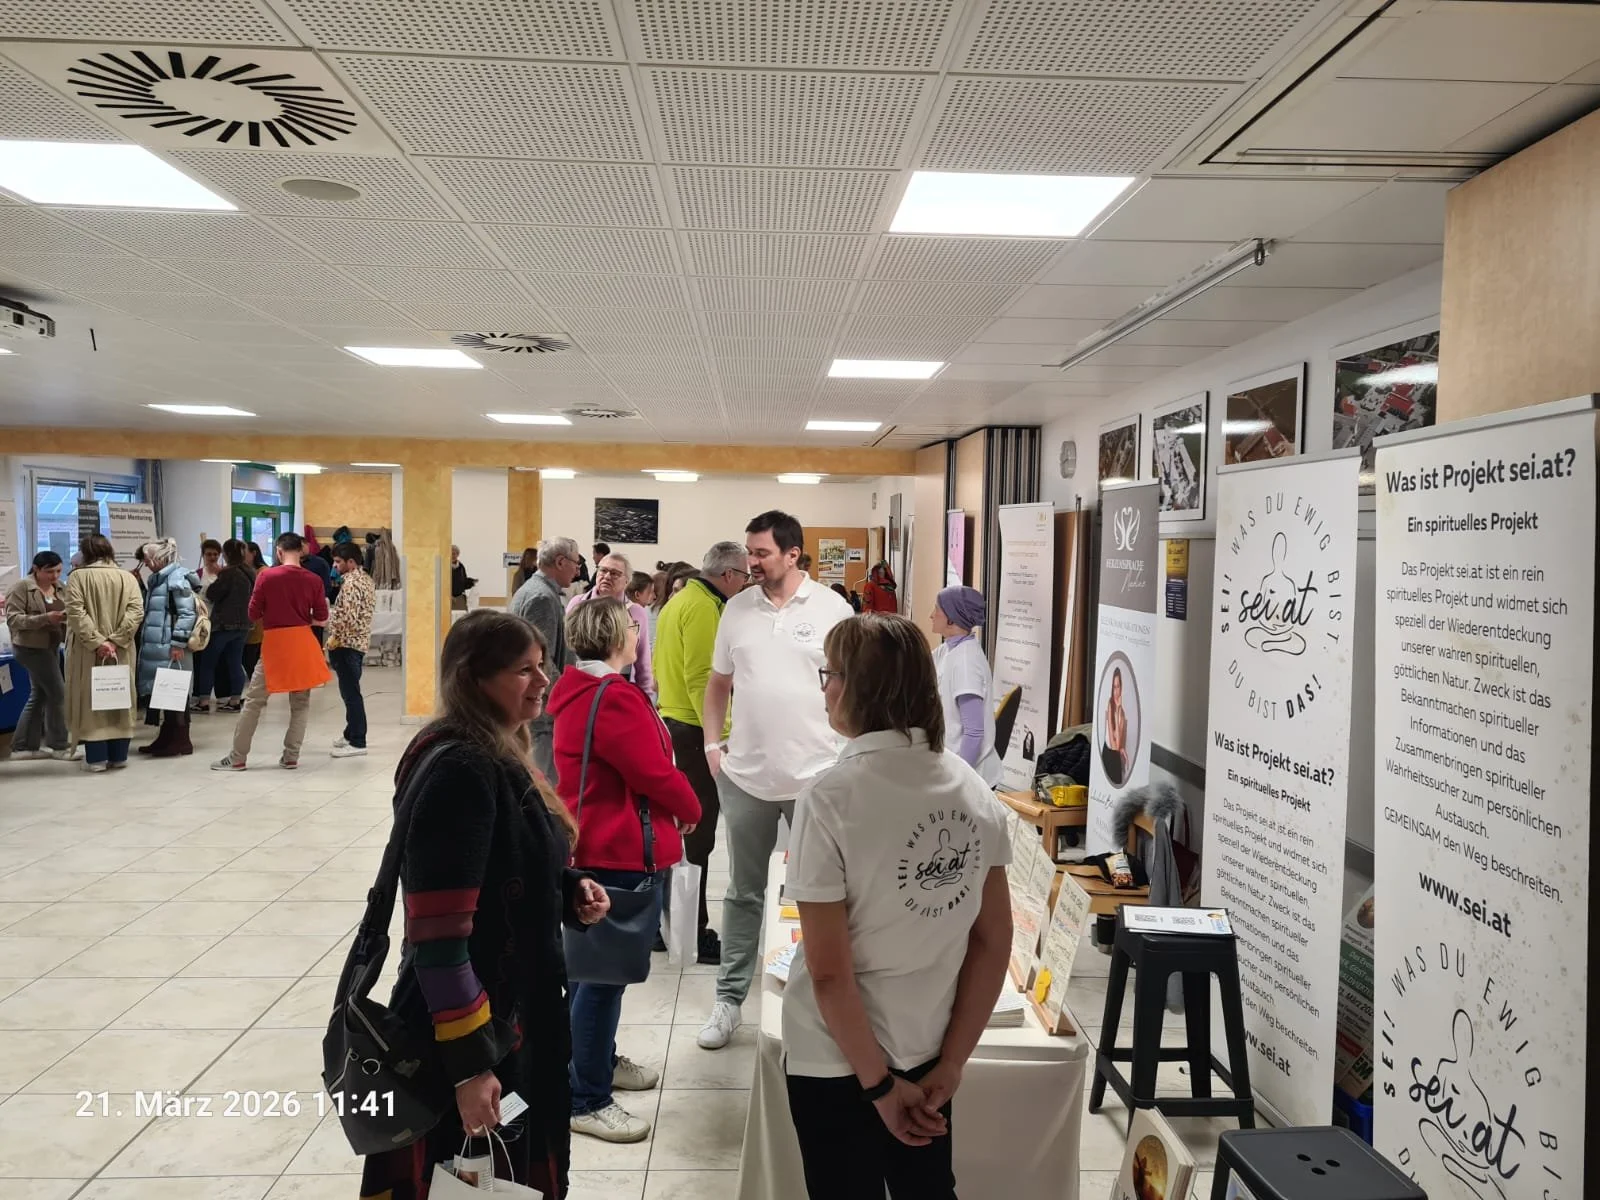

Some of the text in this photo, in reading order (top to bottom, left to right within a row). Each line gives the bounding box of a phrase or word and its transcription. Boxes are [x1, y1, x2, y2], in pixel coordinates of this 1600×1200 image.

[1386, 448, 1576, 493] Was ist Projekt sei.at?
[1408, 512, 1538, 536] Ein spirituelles Projekt
[1220, 573, 1233, 633] SEI!
[1230, 510, 1256, 555] WAS
[1265, 492, 1284, 514] DU
[1294, 496, 1331, 551] EWIG
[1402, 562, 1544, 582] Das Projekt sei.at ist ein rein
[1238, 570, 1318, 626] sei.at
[1387, 587, 1568, 615] spirituelles Projekt und widmet sich
[1395, 614, 1551, 649] speziell der Wiederentdeckung
[1401, 640, 1540, 678] unserer wahren spirituellen,
[1228, 660, 1322, 721] DU BIST DAS!
[1394, 664, 1551, 708] göttlichen Natur. Zweck ist das
[1401, 688, 1539, 736] Bekanntmachen spiritueller
[1215, 731, 1335, 786] Was ist Projekt sei.at?
[1410, 716, 1526, 763] Informationen und das
[1228, 769, 1311, 813] Ein spirituelles Projekt
[1395, 737, 1546, 800] Zusammenbringen spiritueller
[1386, 759, 1562, 838] Wahrheitssucher zum persönlichen
[1435, 803, 1490, 839] Austausch.
[906, 823, 925, 849] WAS
[929, 810, 944, 824] DU
[1213, 813, 1327, 875] spirituelles Projekt und widmet sich
[1224, 798, 1234, 811] Das
[1236, 803, 1258, 822] Projekt
[1278, 825, 1286, 836] ist
[1288, 829, 1298, 840] ein
[1300, 834, 1314, 848] rein
[1218, 833, 1317, 893] speziell der Wiederentdeckung
[1222, 853, 1244, 871] unserer
[1246, 866, 1268, 883] wahren
[1384, 807, 1563, 903] GEMEINSAM den Weg beschreiten.
[1217, 868, 1315, 932] göttlichen Natur. Zweck ist das
[1221, 886, 1270, 923] Bekanntmachen
[1272, 919, 1308, 947] spiritueller
[1419, 872, 1511, 937] www.sei.at
[1272, 940, 1284, 953] und
[1287, 949, 1300, 962] das
[1274, 960, 1312, 990] spiritueller
[1246, 996, 1257, 1012] den
[1259, 1007, 1274, 1027] Weg
[1259, 969, 1272, 984] zum
[1275, 981, 1319, 1018] persönlichen
[1382, 1010, 1396, 1098] SEI!
[1391, 946, 1426, 997] WAS
[1440, 942, 1465, 978] DU
[1483, 977, 1542, 1087] EWIG
